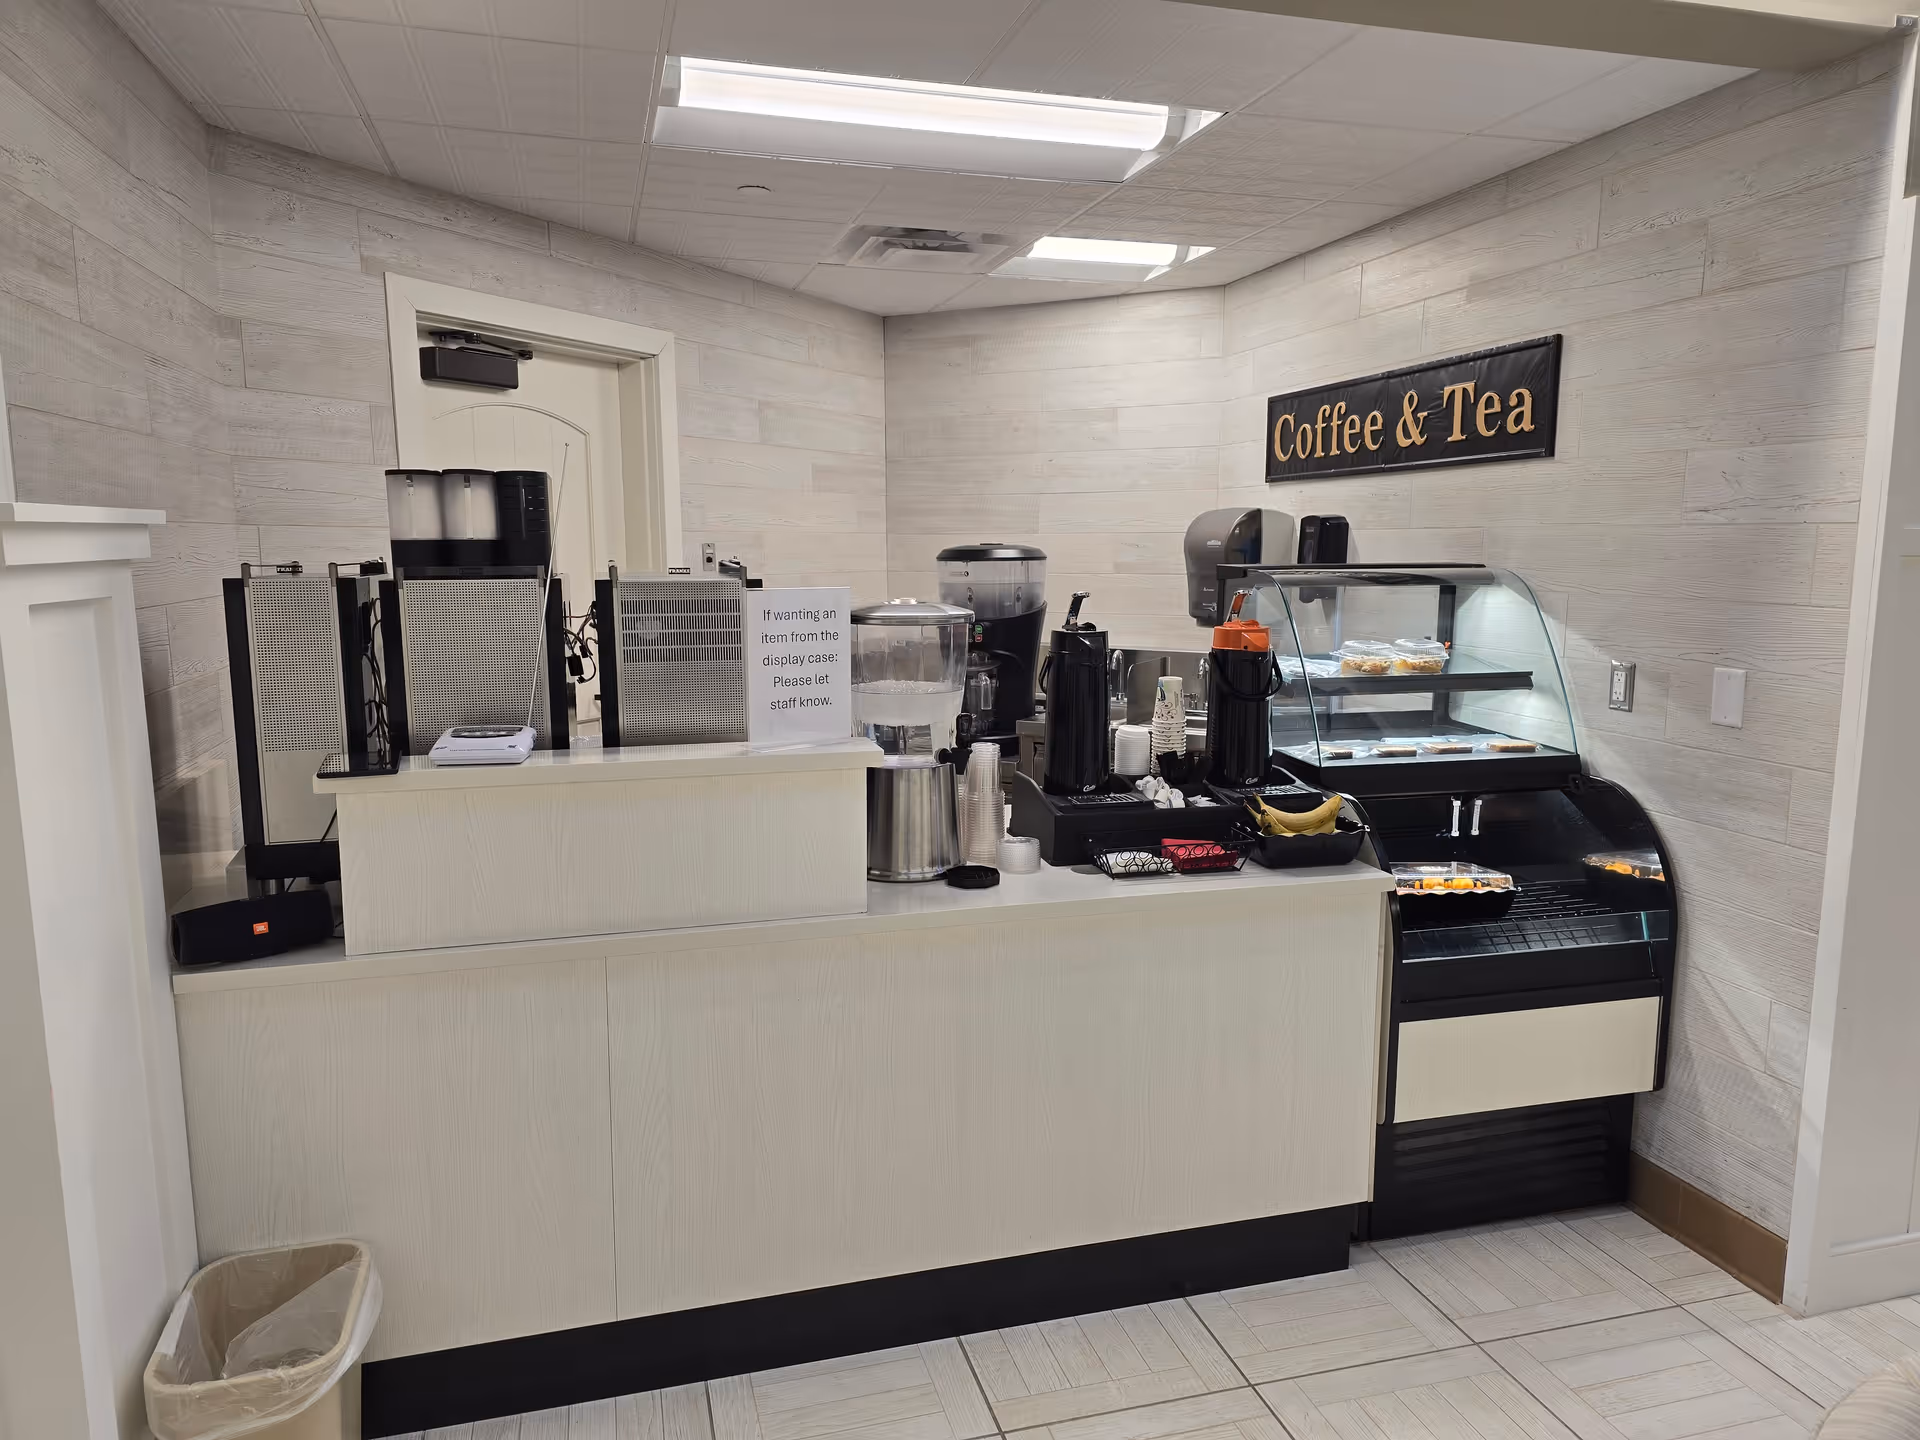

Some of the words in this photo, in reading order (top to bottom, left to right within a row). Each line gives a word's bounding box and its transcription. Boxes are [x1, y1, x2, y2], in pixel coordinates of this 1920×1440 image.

[1274, 400, 1384, 462] Coffee
[1395, 389, 1428, 448] &
[1443, 380, 1536, 443] Tea
[763, 609, 771, 621] If
[773, 608, 820, 623] wanting
[822, 609, 837, 619] an
[761, 632, 788, 644] item
[791, 631, 818, 643] from
[820, 630, 839, 641] the
[762, 653, 805, 668] display
[808, 653, 838, 664] case:
[773, 675, 812, 688] Please
[815, 673, 830, 685] let
[770, 697, 797, 710] staff
[799, 696, 832, 708] know.
